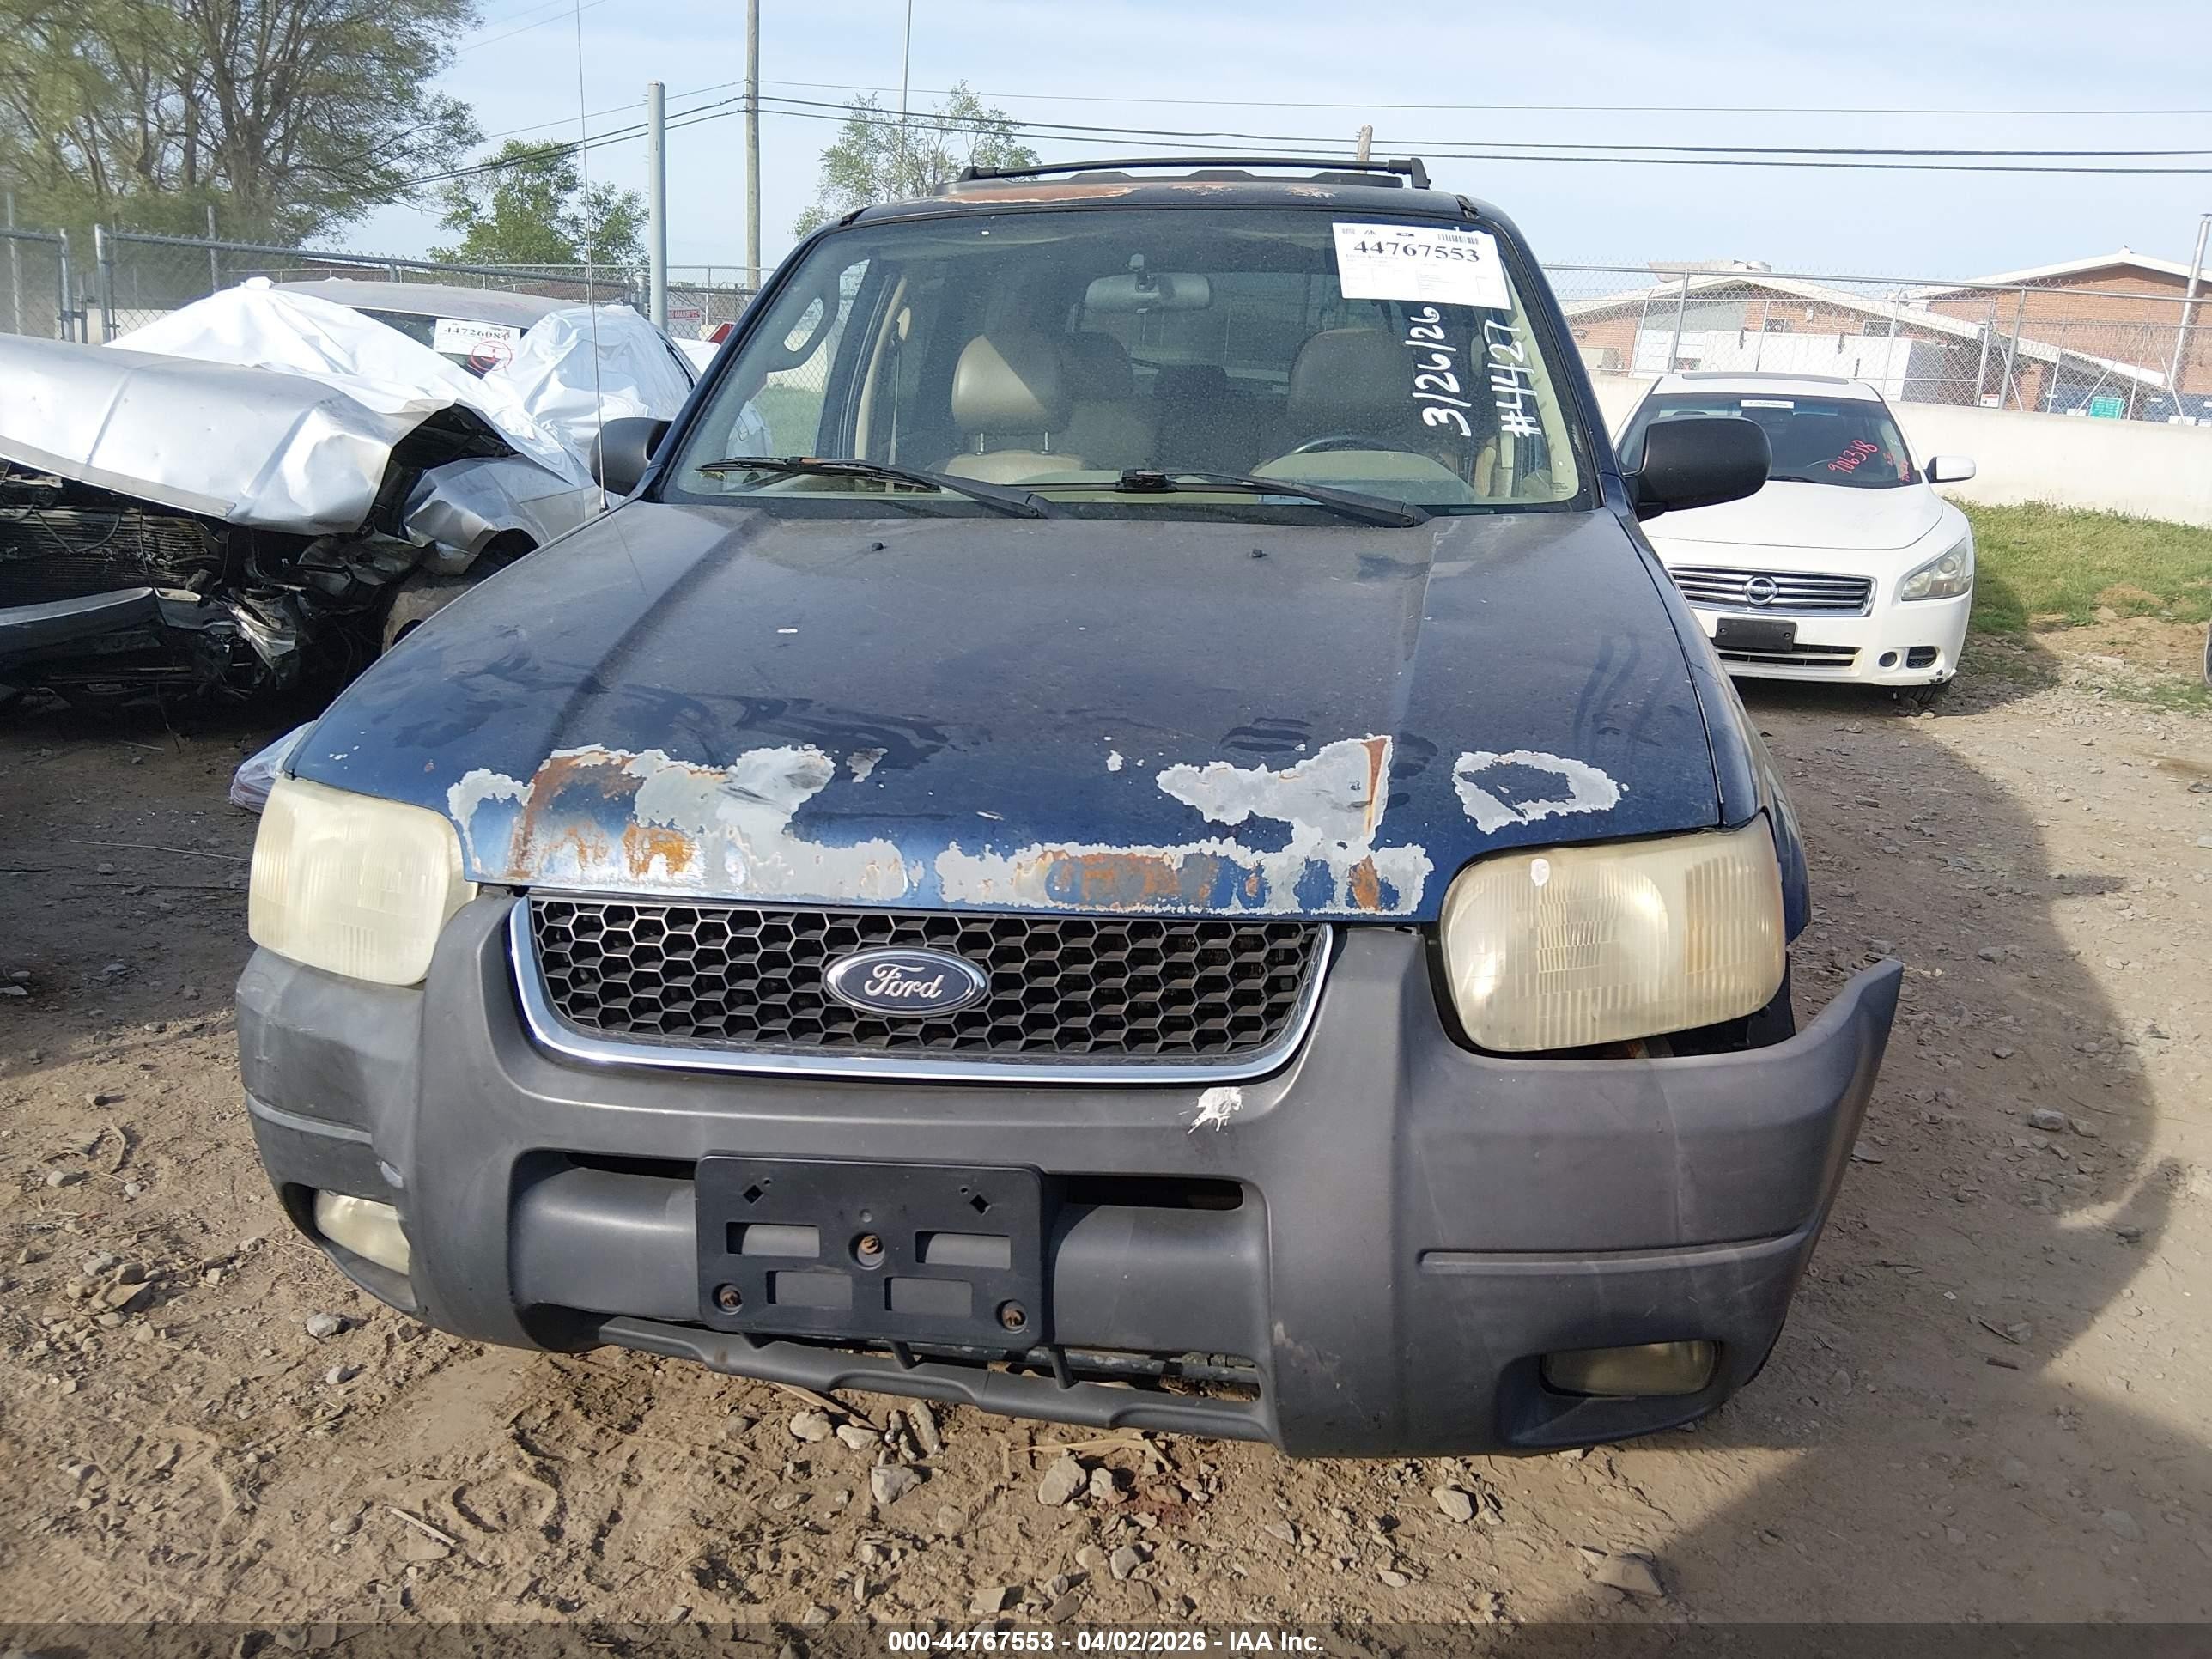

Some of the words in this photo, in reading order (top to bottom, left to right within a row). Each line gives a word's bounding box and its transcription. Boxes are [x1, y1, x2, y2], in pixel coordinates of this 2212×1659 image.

[1353, 240, 1480, 263] 44767553
[1404, 306, 1472, 437] 3/26/26
[1484, 319, 1541, 438] #4427
[864, 963, 945, 998] Ford
